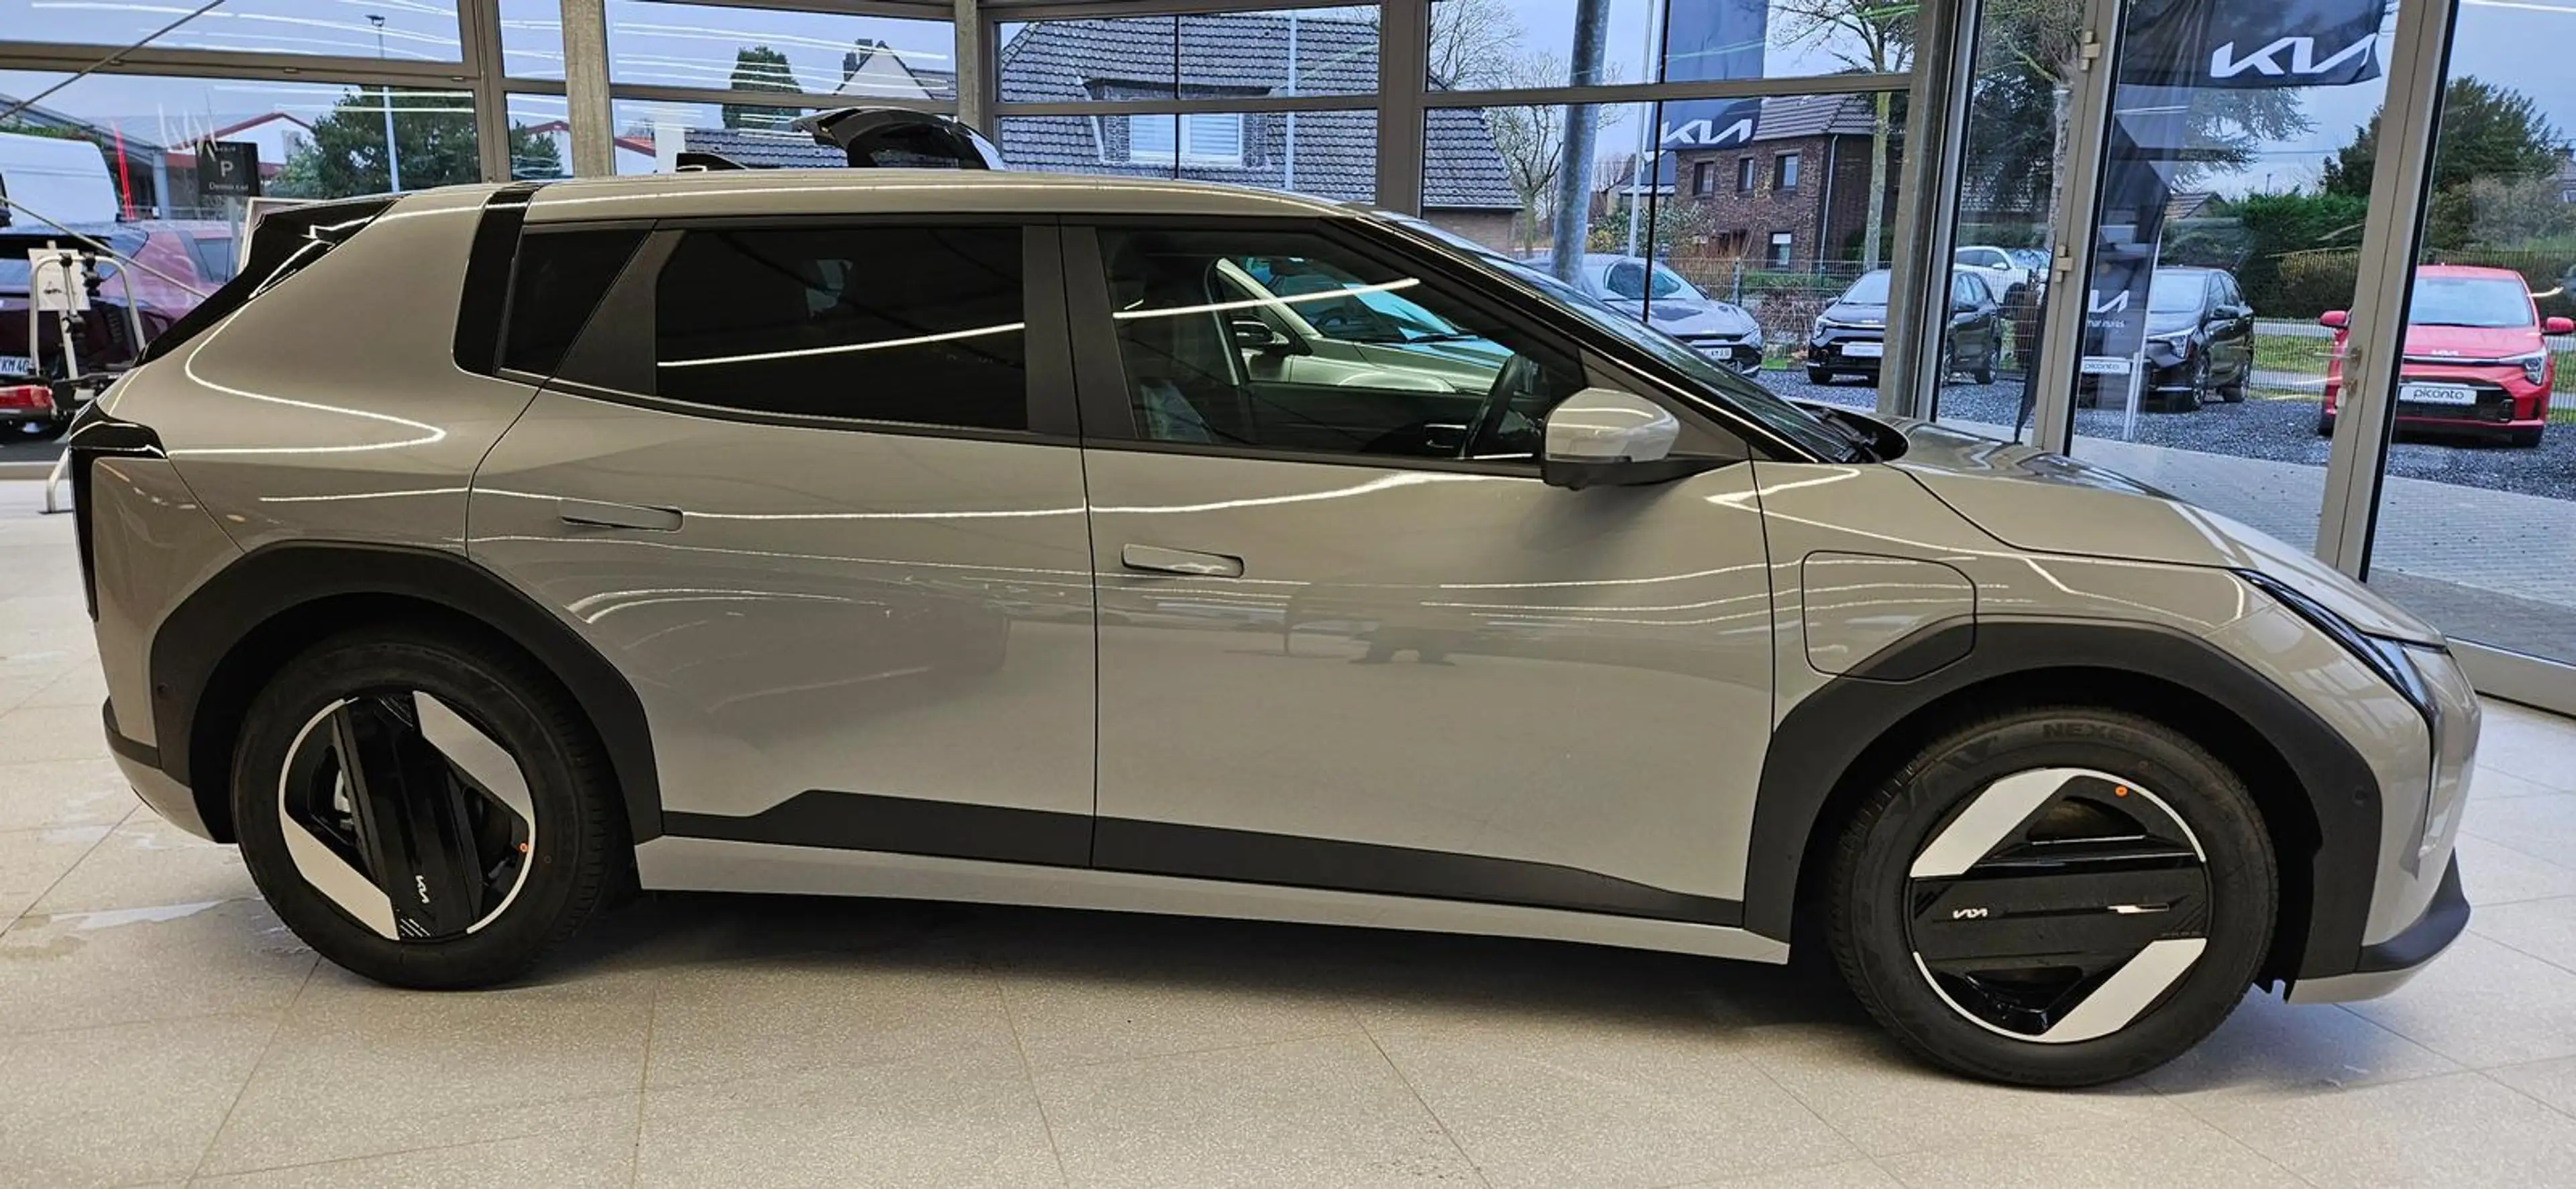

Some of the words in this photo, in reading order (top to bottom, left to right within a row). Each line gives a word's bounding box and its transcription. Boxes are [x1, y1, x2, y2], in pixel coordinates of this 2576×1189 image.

[2210, 33, 2377, 78] KIA
[1660, 119, 1753, 144] KIA
[221, 160, 233, 177] P
[2414, 388, 2464, 400] picanto
[1953, 907, 1988, 919] KIA
